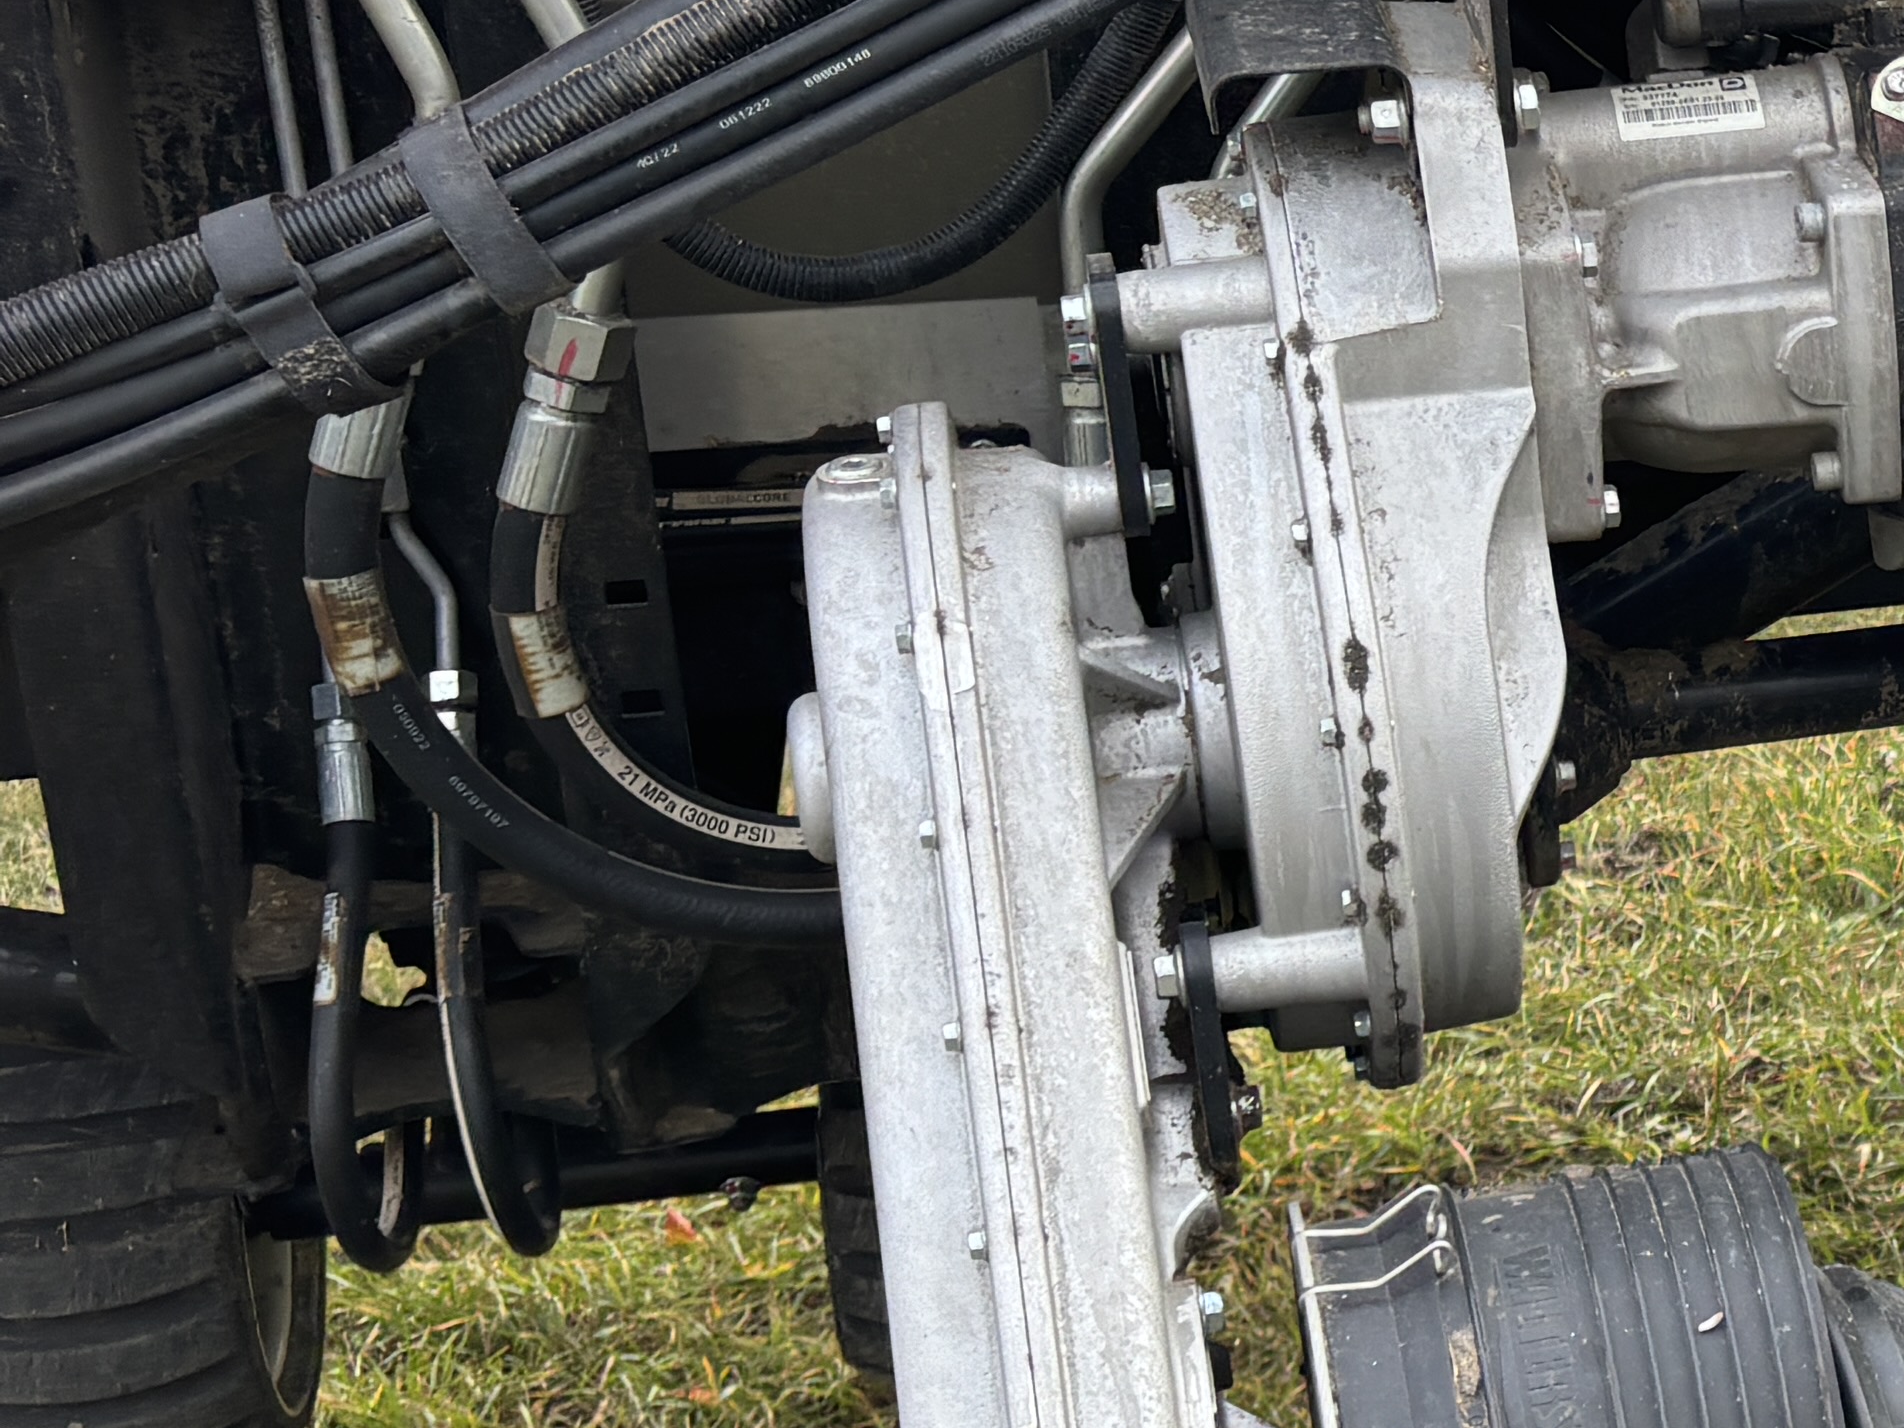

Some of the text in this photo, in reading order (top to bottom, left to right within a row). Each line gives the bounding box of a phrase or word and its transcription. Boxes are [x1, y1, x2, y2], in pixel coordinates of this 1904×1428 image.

[616, 764, 776, 846] 21 MPa (3000 PSI)
